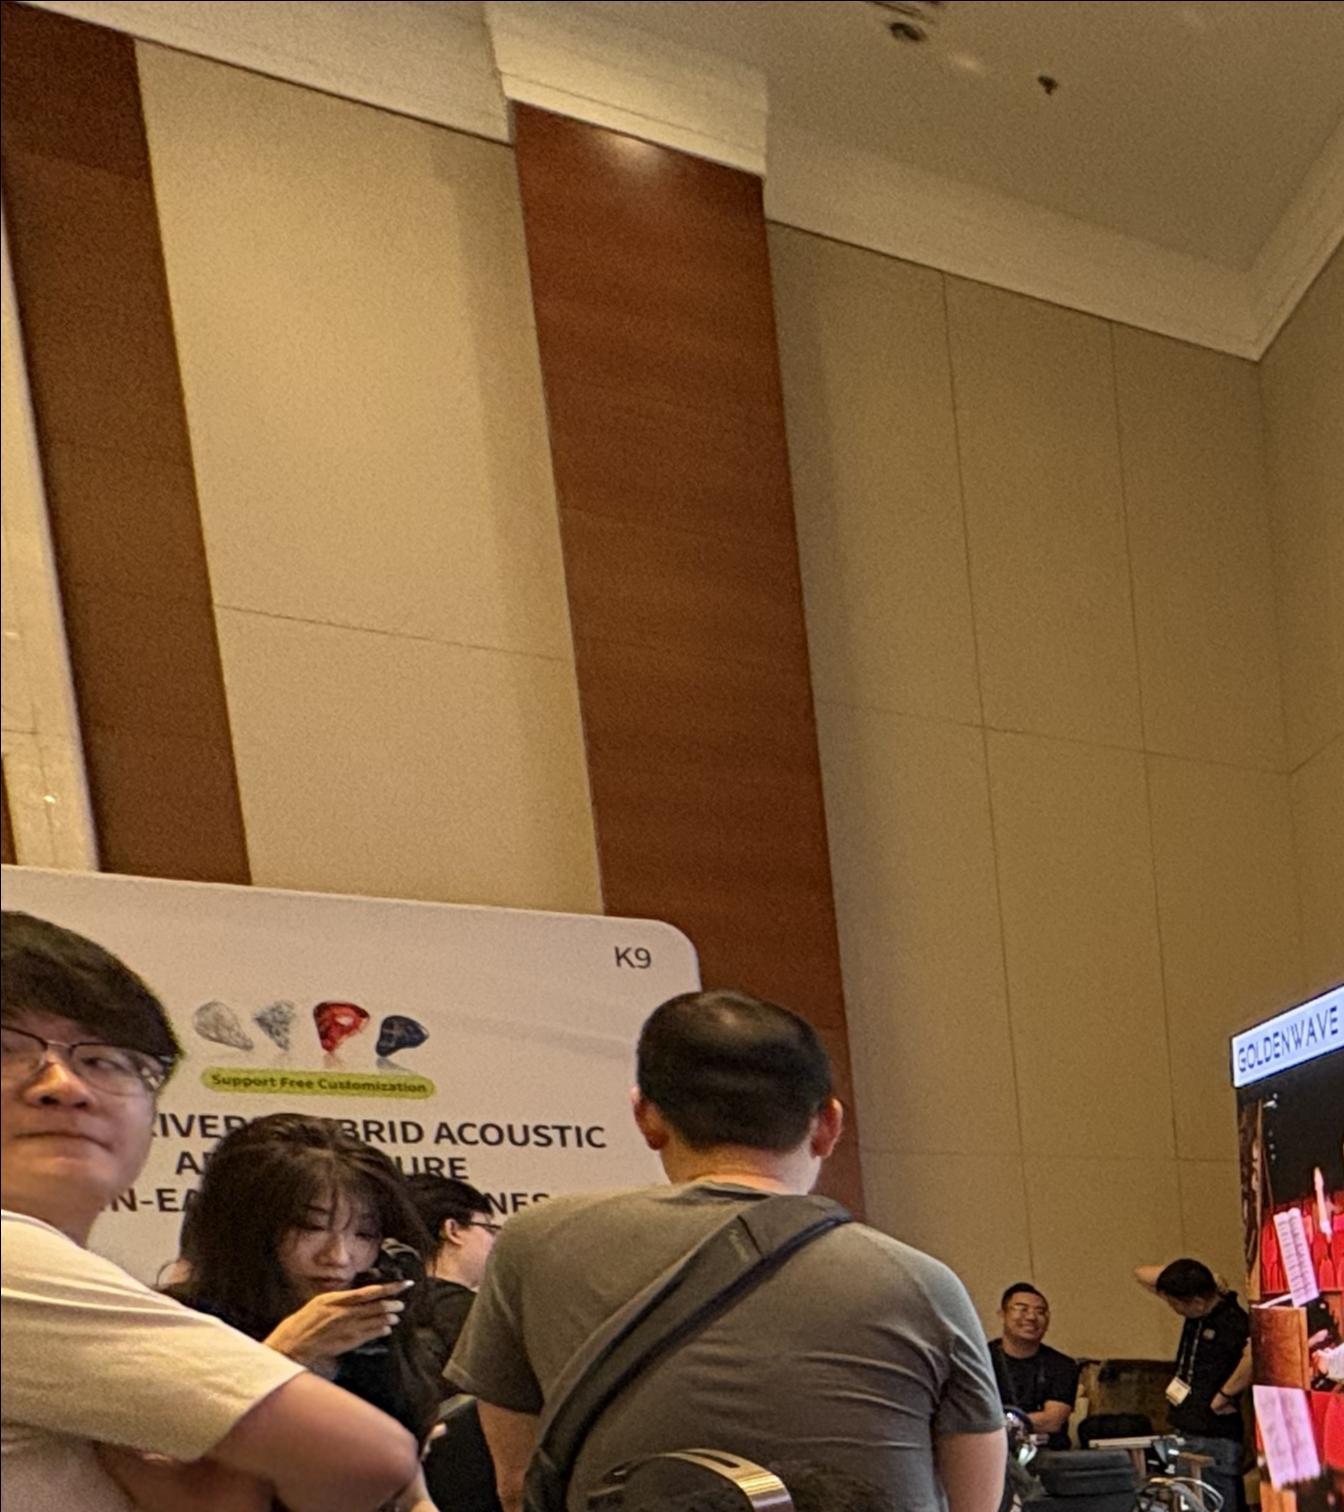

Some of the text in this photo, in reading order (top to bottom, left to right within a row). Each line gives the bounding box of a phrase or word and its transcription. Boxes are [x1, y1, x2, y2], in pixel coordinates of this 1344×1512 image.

[614, 945, 652, 969] K9
[1238, 1005, 1338, 1073] GOLDENWAVE
[211, 1072, 428, 1093] Support Free Customization
[433, 1121, 608, 1149] ACOUSTIC
